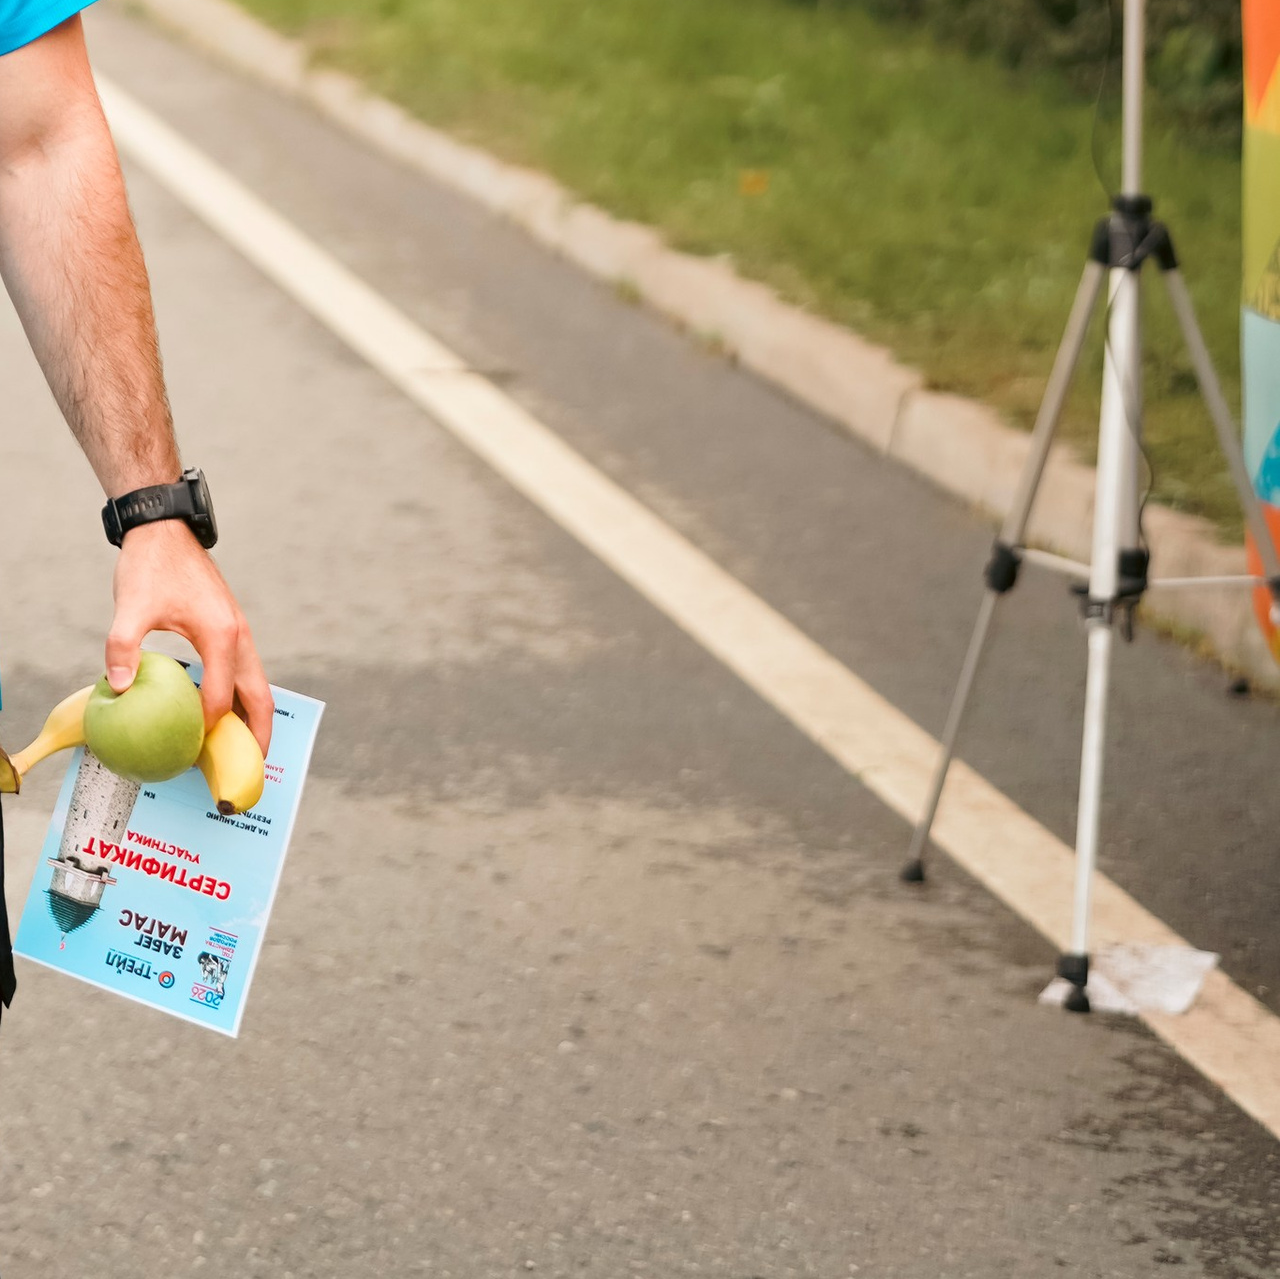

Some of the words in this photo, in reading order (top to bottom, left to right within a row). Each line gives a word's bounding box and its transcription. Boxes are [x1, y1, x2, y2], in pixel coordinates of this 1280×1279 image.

[274, 707, 289, 717] ИЮН
[143, 789, 156, 800] КМ
[206, 811, 257, 833] ДИСТАНЦИЮ
[239, 810, 271, 824] РЕЗУЛЬ
[258, 828, 269, 837] НА
[126, 829, 200, 865] УЧАСТНИКА
[81, 836, 232, 901] СЕРТИФИКАТ
[118, 909, 188, 946] МАГАС
[133, 933, 184, 959] ЗАБЕГ
[191, 986, 221, 1006] 2026
